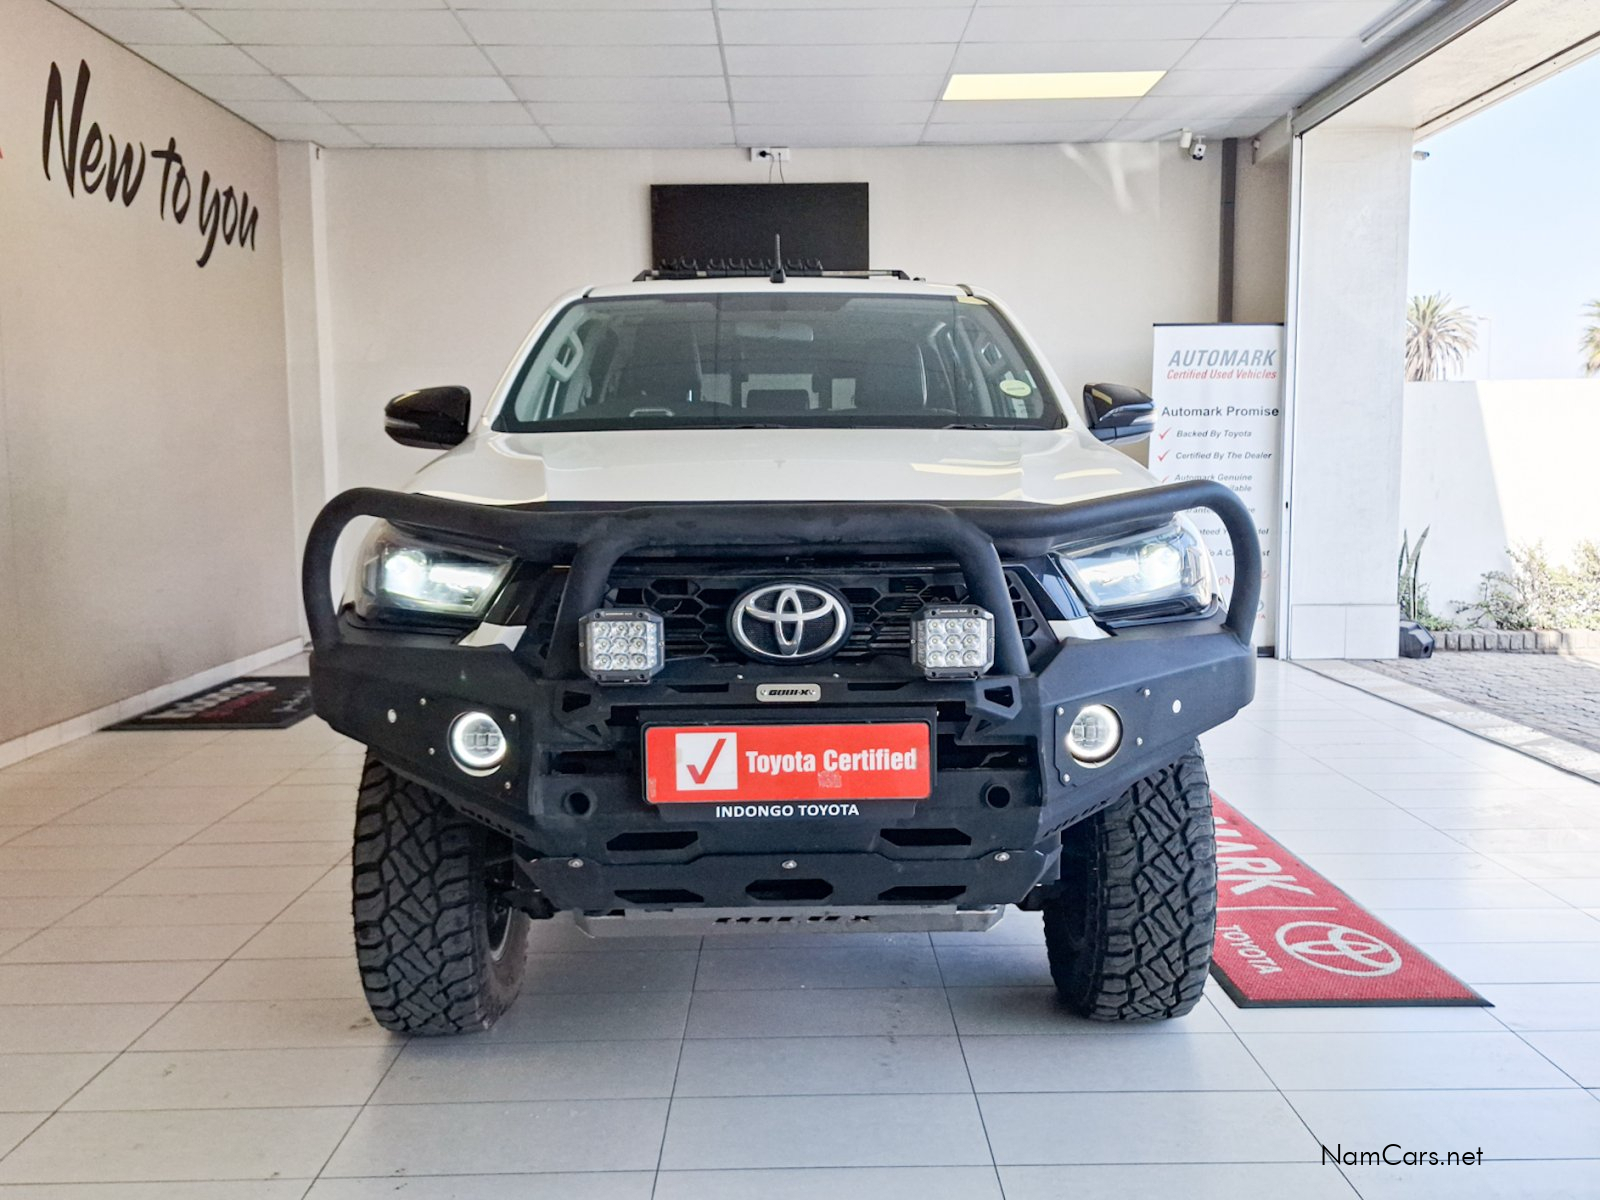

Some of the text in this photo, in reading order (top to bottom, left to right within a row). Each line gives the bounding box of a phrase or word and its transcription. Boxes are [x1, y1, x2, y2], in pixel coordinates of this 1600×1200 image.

[42, 58, 259, 268] New to you
[1168, 349, 1278, 367] AUTOMARK
[1167, 369, 1277, 380] Certified Used Vehicles
[1161, 405, 1279, 417] Automark Promise
[1176, 429, 1252, 439] Backed By Toyota
[1175, 451, 1272, 461] Certified By The Dealer
[1217, 473, 1253, 481] Genuine
[745, 747, 917, 775] Toyota Certified
[715, 803, 860, 818] INDONGO TOYOTA
[1216, 923, 1283, 975] TOYOTA
